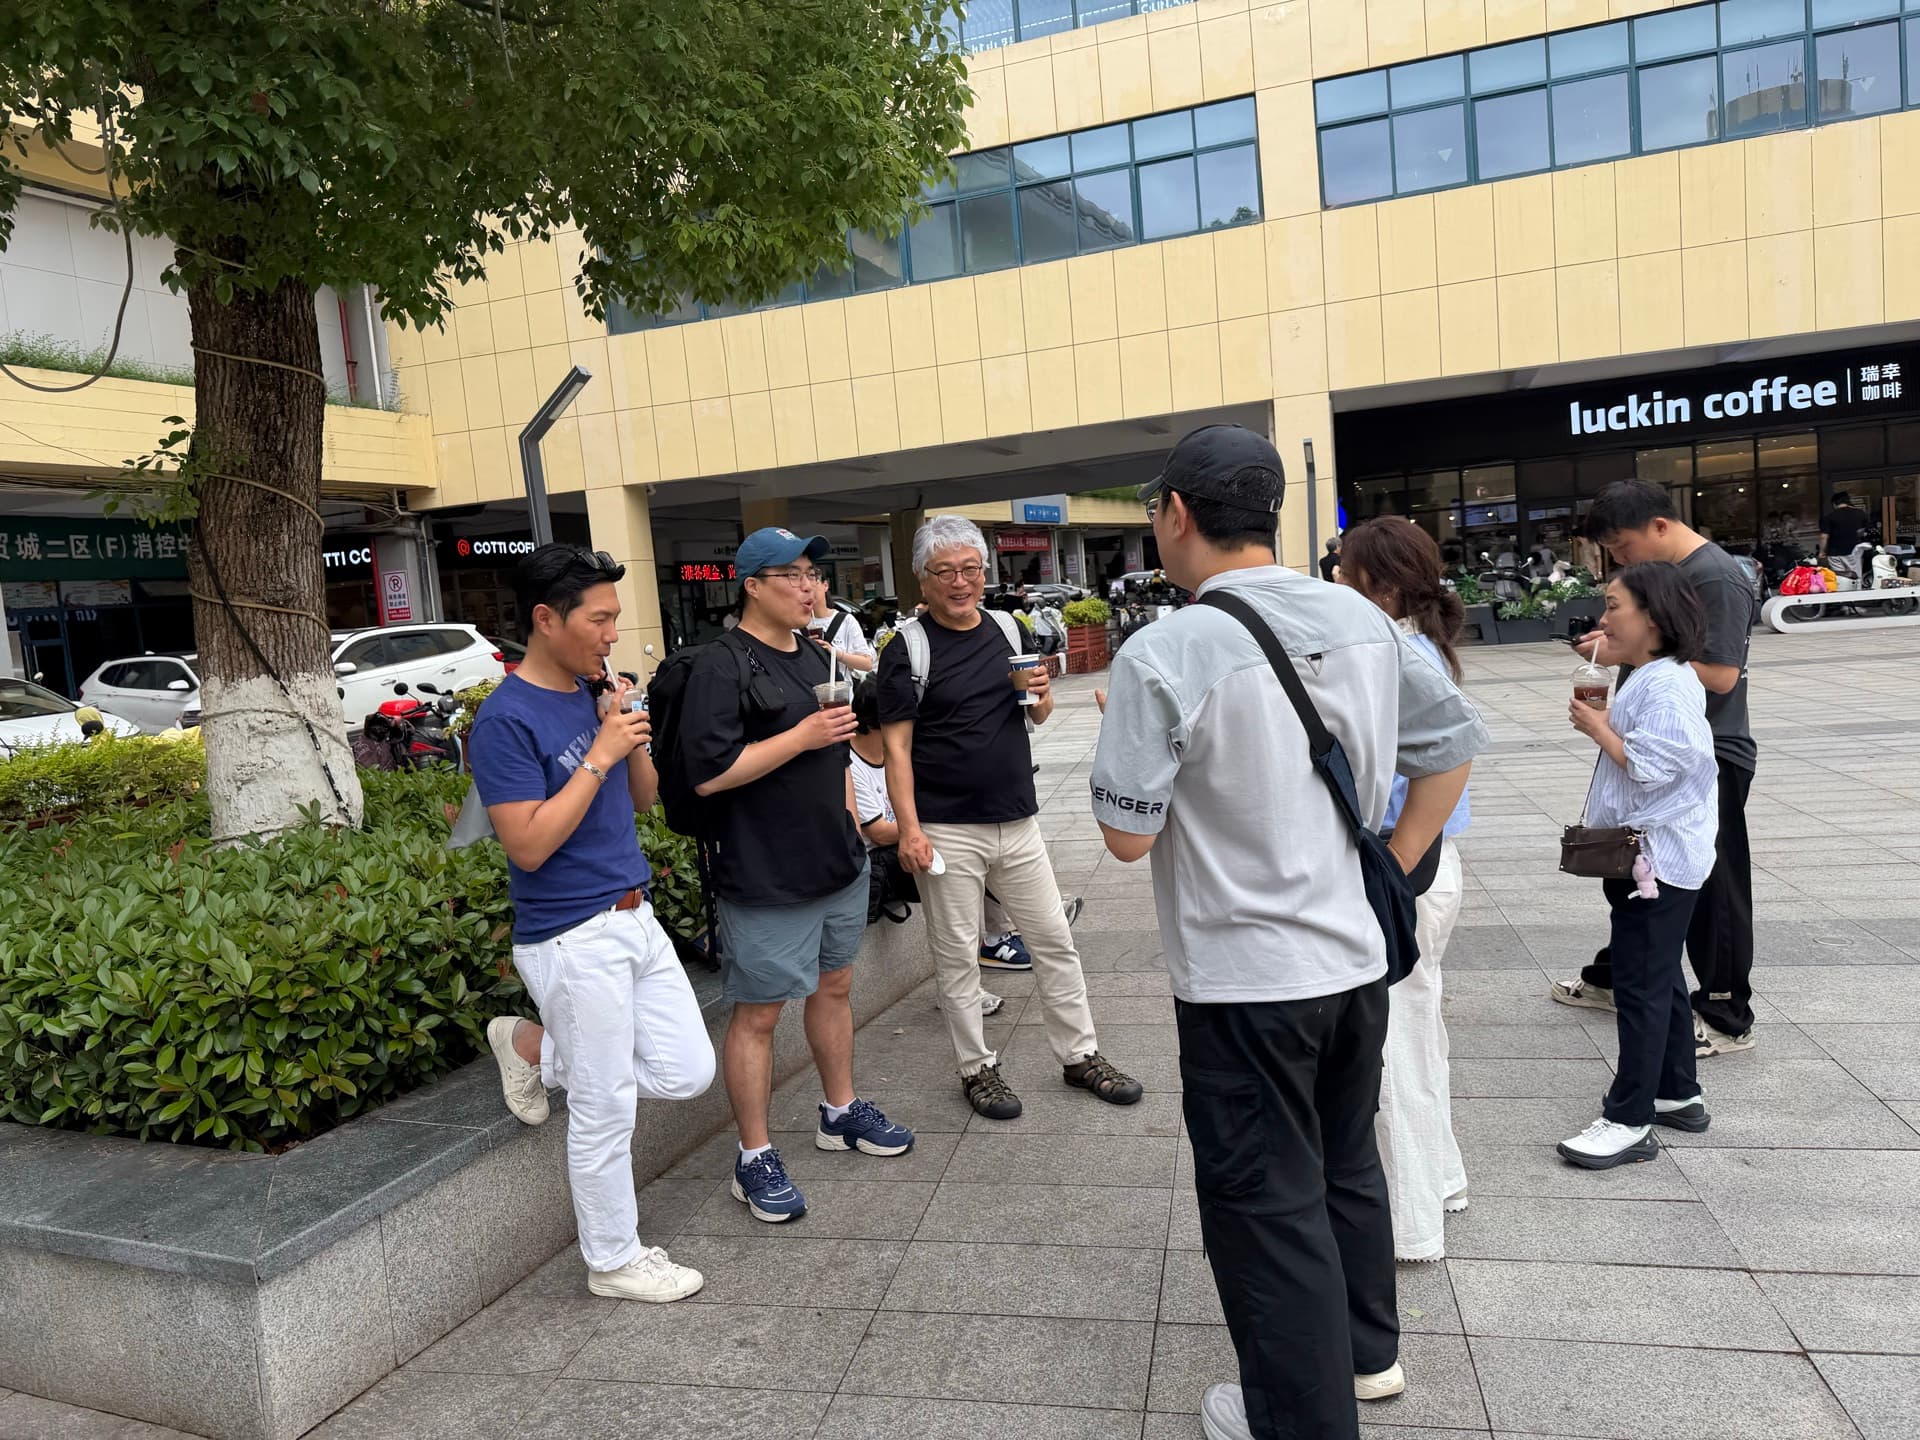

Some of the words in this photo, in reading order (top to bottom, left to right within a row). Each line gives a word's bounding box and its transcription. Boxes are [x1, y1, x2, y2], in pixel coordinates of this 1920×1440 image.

[1860, 362, 1901, 382] 瑞幸
[1861, 381, 1902, 401] 咖啡
[1570, 390, 1691, 435] luckin
[1703, 376, 1837, 419] coffee
[473, 541, 507, 554] COTTI
[322, 550, 346, 568] TTI
[1093, 786, 1164, 815] ENGER
